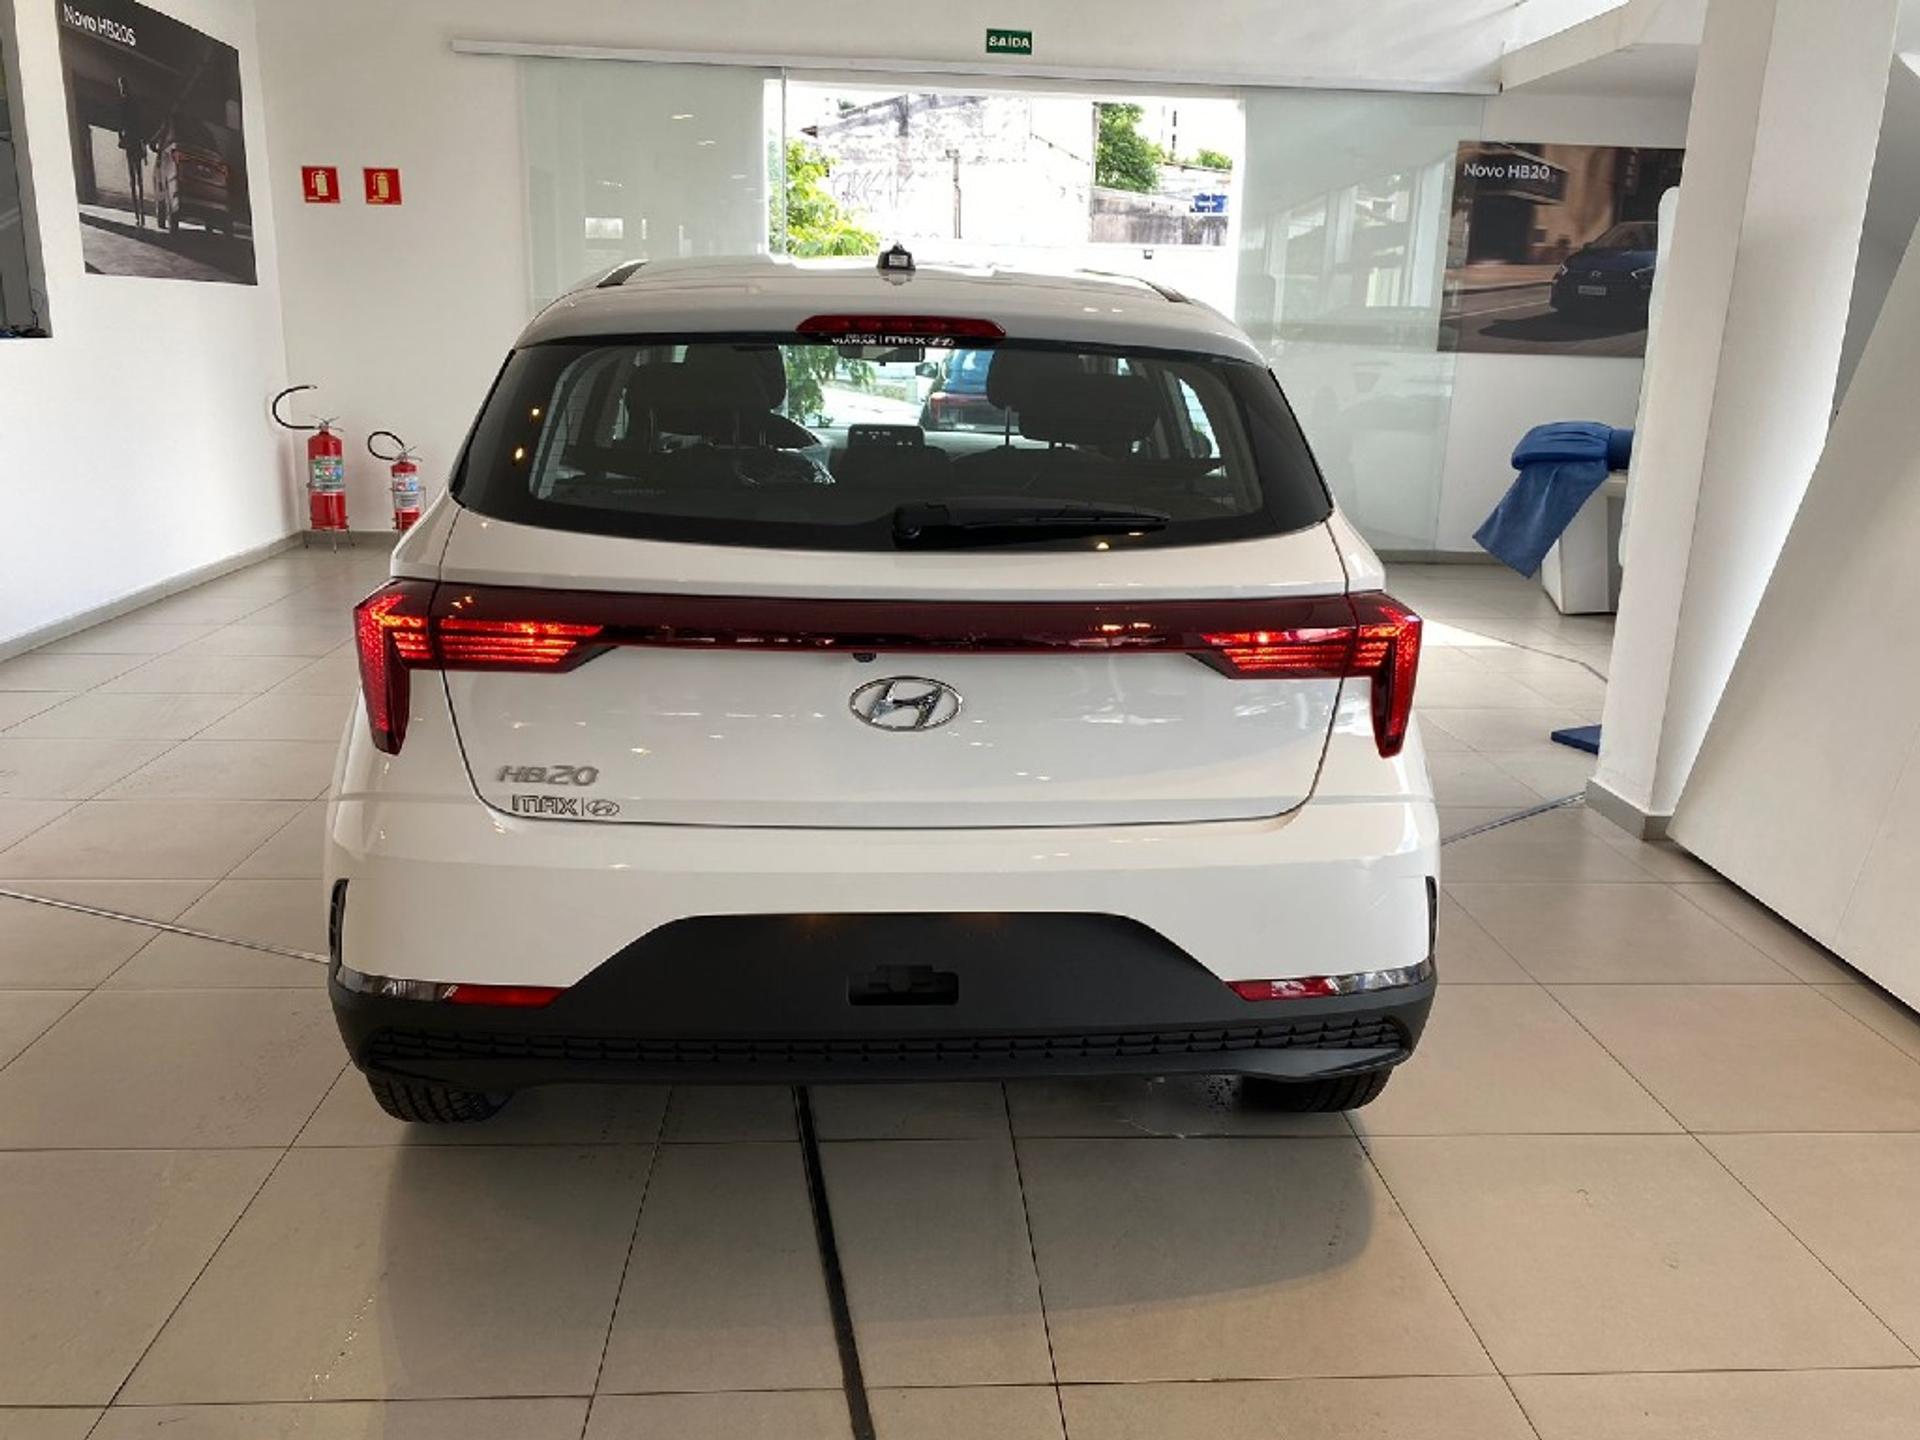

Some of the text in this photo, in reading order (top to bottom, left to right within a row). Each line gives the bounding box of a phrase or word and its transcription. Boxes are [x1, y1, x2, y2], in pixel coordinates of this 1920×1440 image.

[64, 3, 136, 46] Novo HB20S
[1464, 163, 1550, 179] Novo HB20
[497, 765, 599, 786] HB20
[511, 795, 578, 816] MAX
